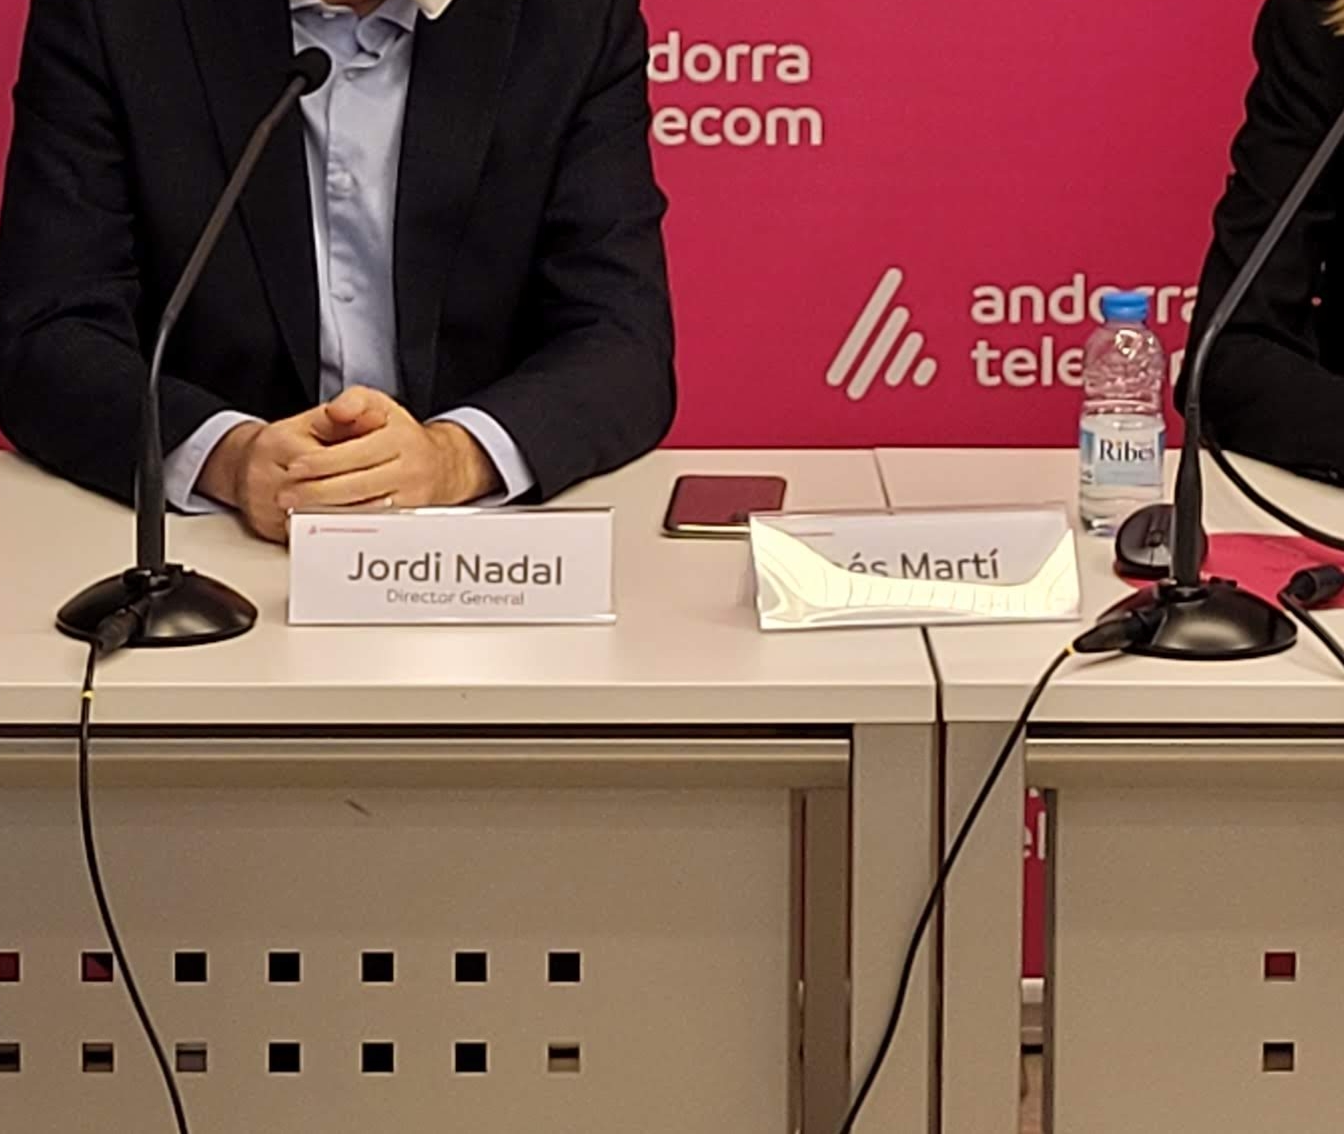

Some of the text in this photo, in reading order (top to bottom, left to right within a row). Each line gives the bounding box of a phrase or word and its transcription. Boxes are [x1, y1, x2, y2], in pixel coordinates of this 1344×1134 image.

[647, 31, 810, 83] dorra
[652, 107, 823, 146] ecom
[348, 551, 562, 586] Jordi Nadal
[832, 548, 999, 580] és Martí
[386, 589, 524, 606] Director General
